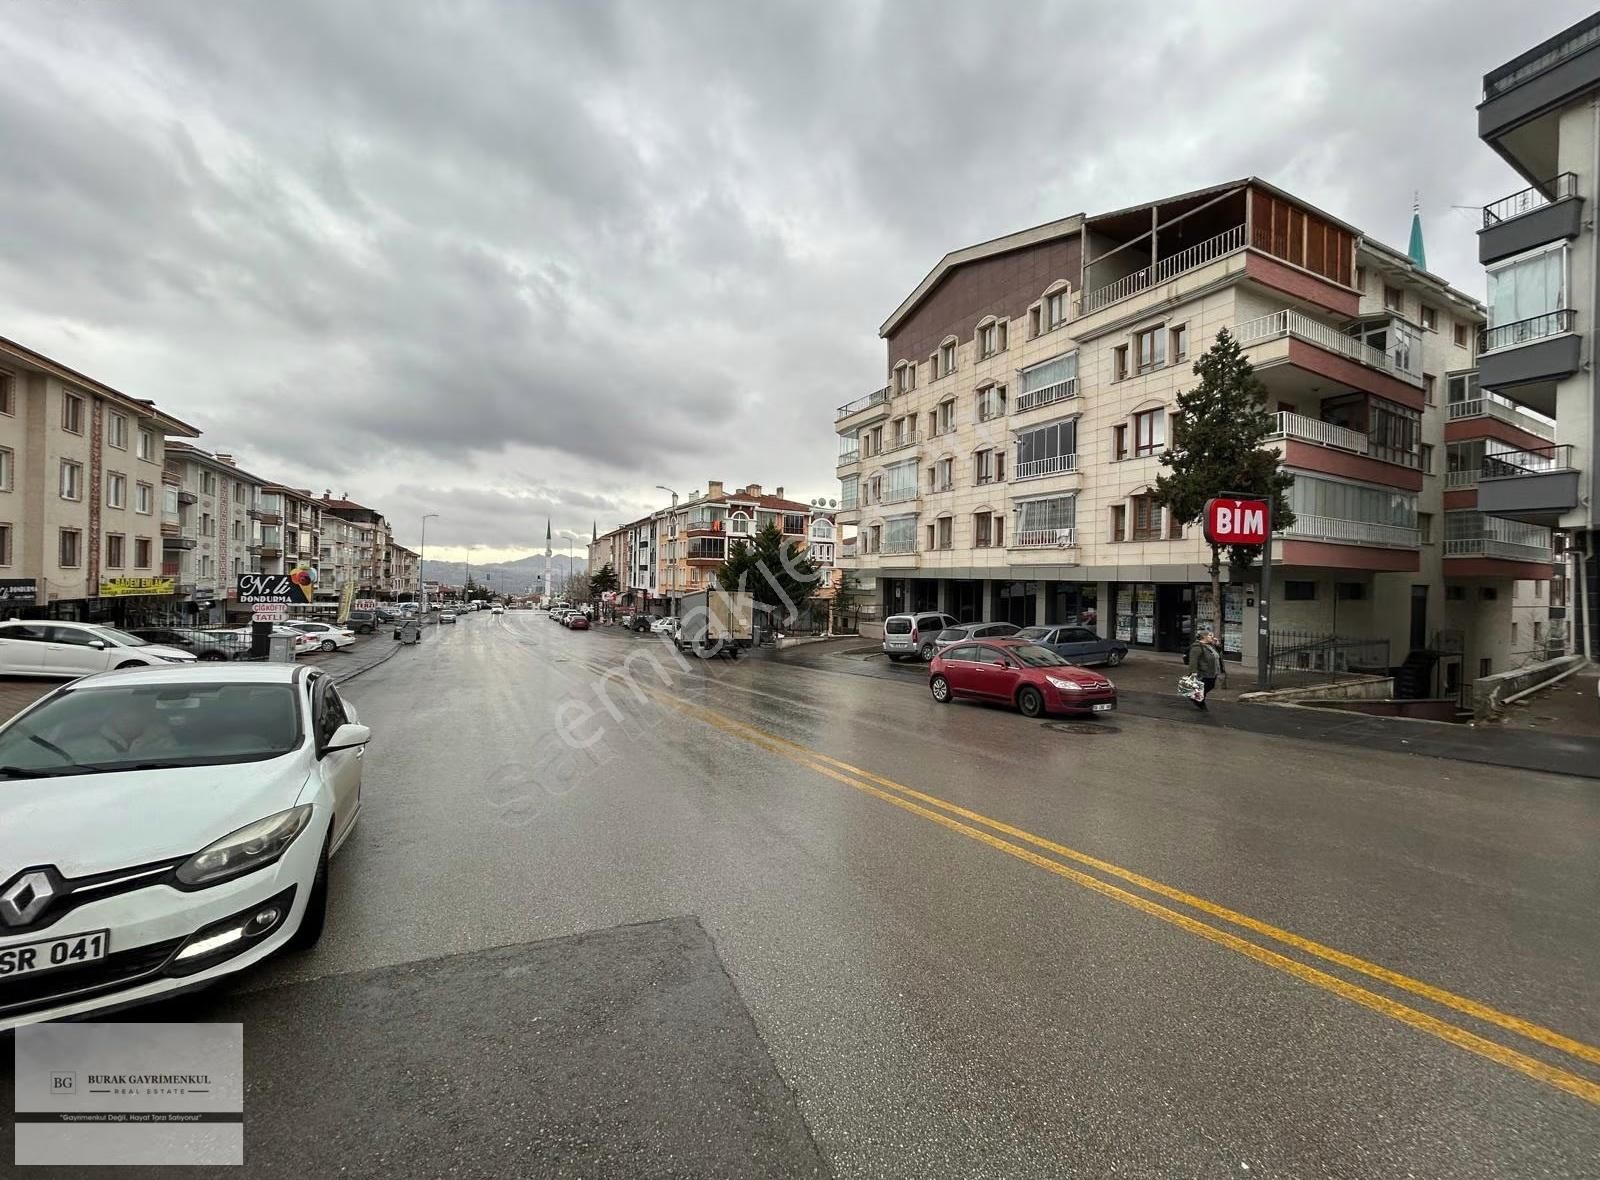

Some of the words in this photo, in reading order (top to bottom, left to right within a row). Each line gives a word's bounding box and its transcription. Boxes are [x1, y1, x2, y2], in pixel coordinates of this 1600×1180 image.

[1216, 501, 1264, 535] BİM
[240, 595, 292, 603] DONDURMA
[50, 935, 102, 965] 041
